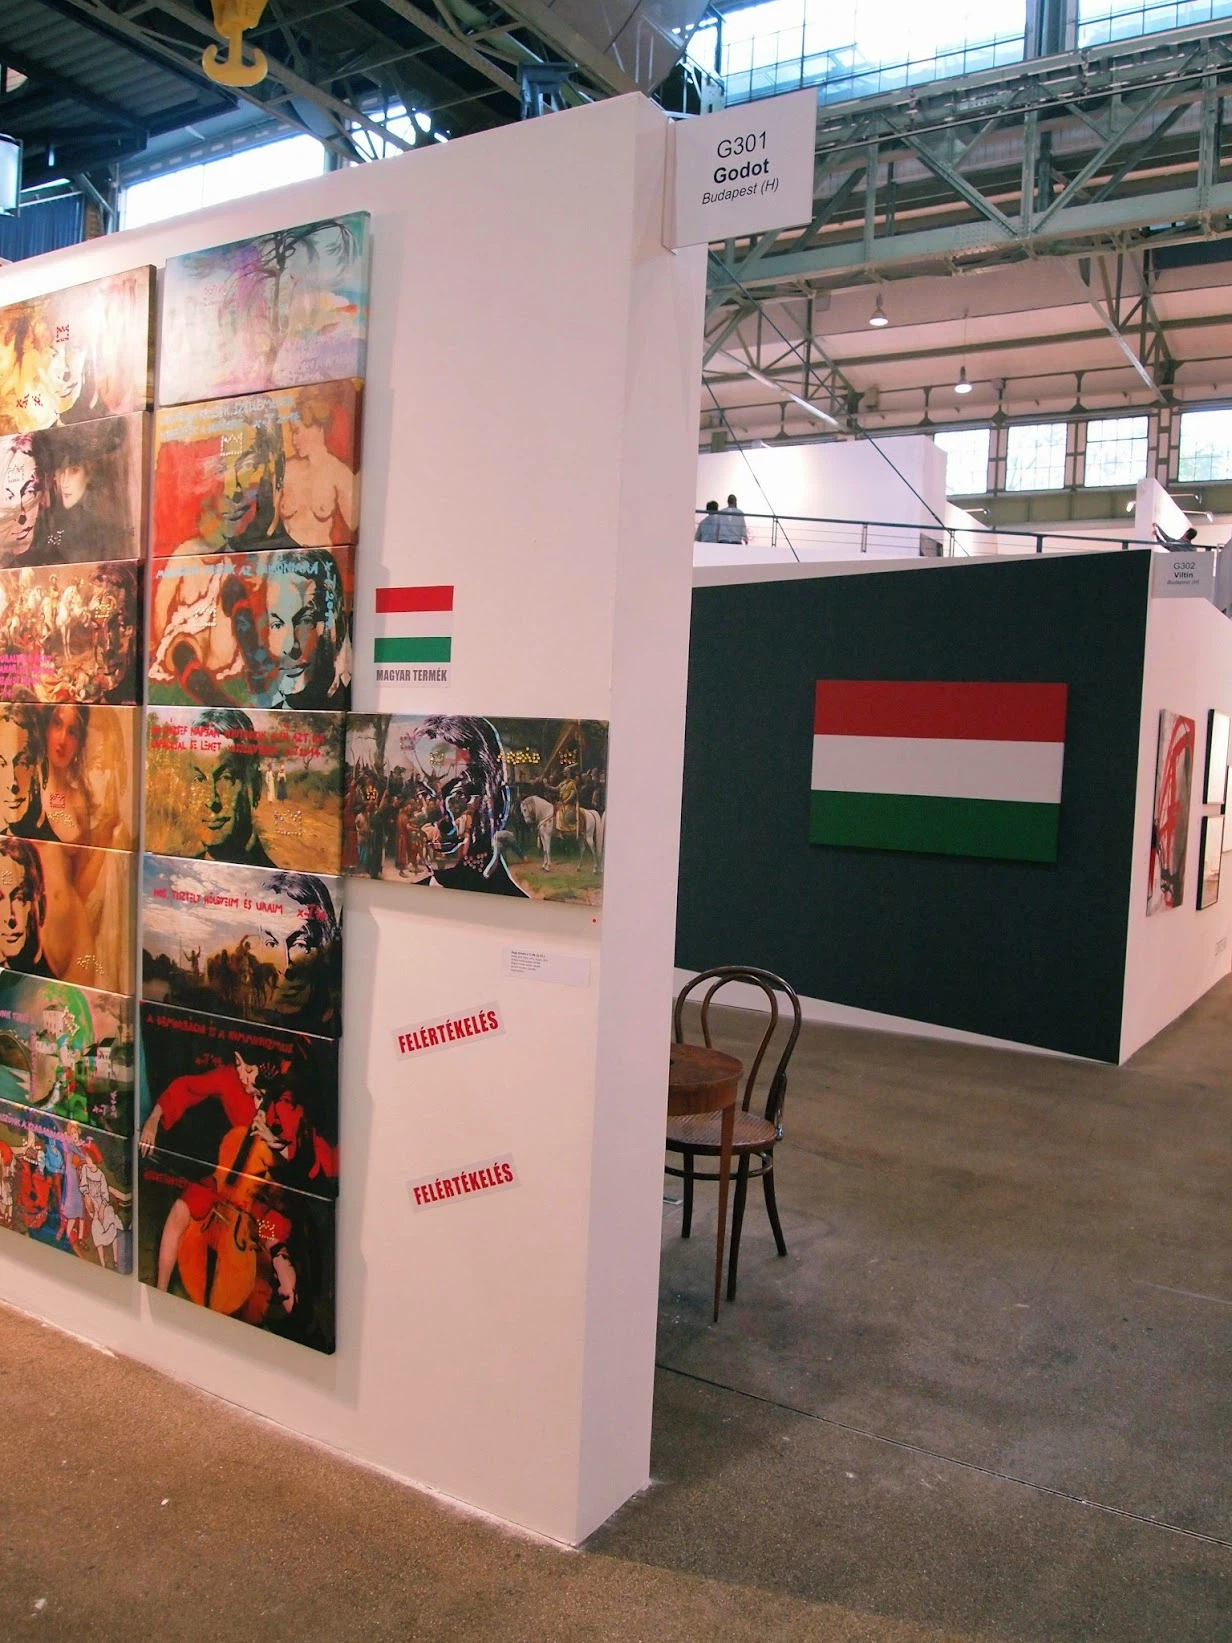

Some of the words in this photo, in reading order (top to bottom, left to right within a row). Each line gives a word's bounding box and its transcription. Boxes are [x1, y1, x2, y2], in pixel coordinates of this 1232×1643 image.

[717, 131, 767, 158] G301
[713, 158, 770, 184] Godot
[702, 183, 758, 205] Budapest
[761, 178, 779, 196] (H)
[1173, 562, 1196, 570] G302
[376, 669, 411, 680] MAGYAR
[413, 667, 447, 681] TERMÉK
[398, 1010, 499, 1054] FELÉRTÉKELÉS
[413, 1162, 514, 1206] FELÉRTÉKELÉS
